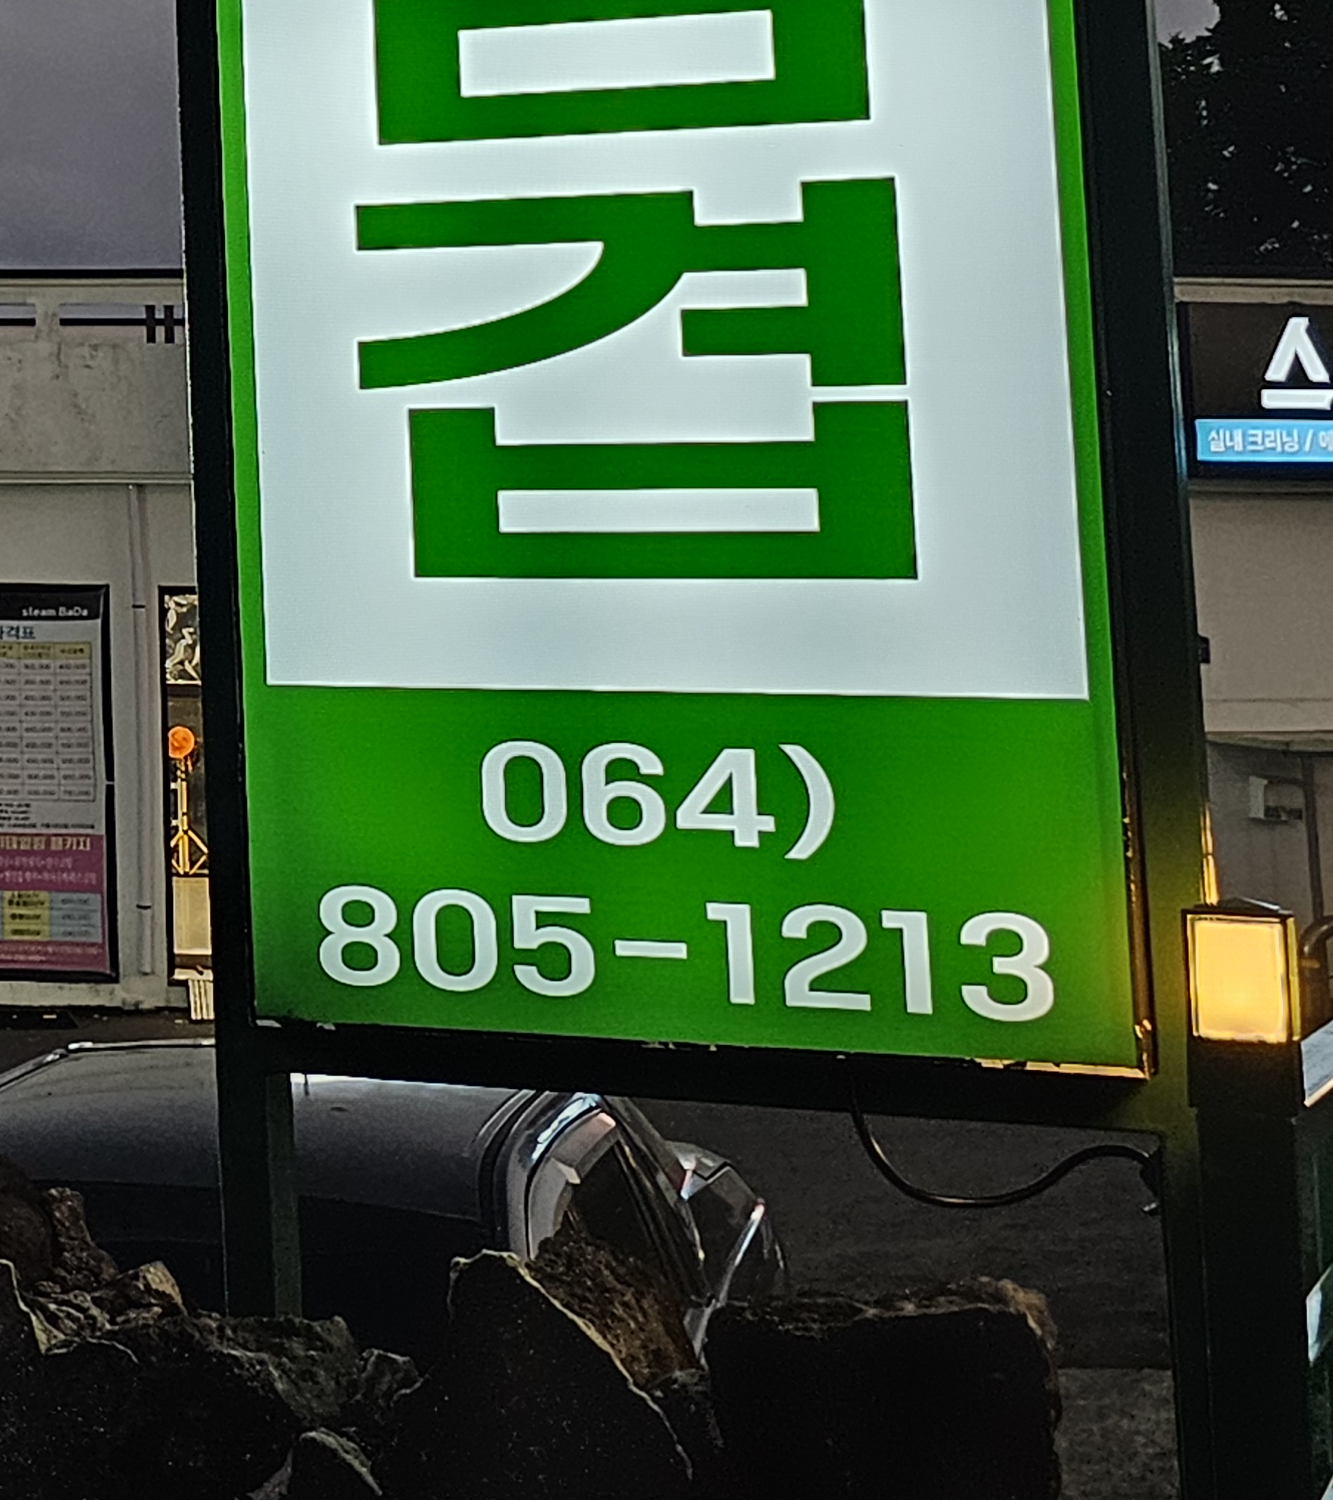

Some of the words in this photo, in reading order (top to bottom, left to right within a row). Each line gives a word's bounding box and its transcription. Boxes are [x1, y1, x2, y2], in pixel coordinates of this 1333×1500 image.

[1208, 429, 1243, 452] 실내
[1247, 429, 1299, 453] 크리닝
[480, 739, 836, 860] 064)
[316, 885, 1056, 1022] 805-1213
